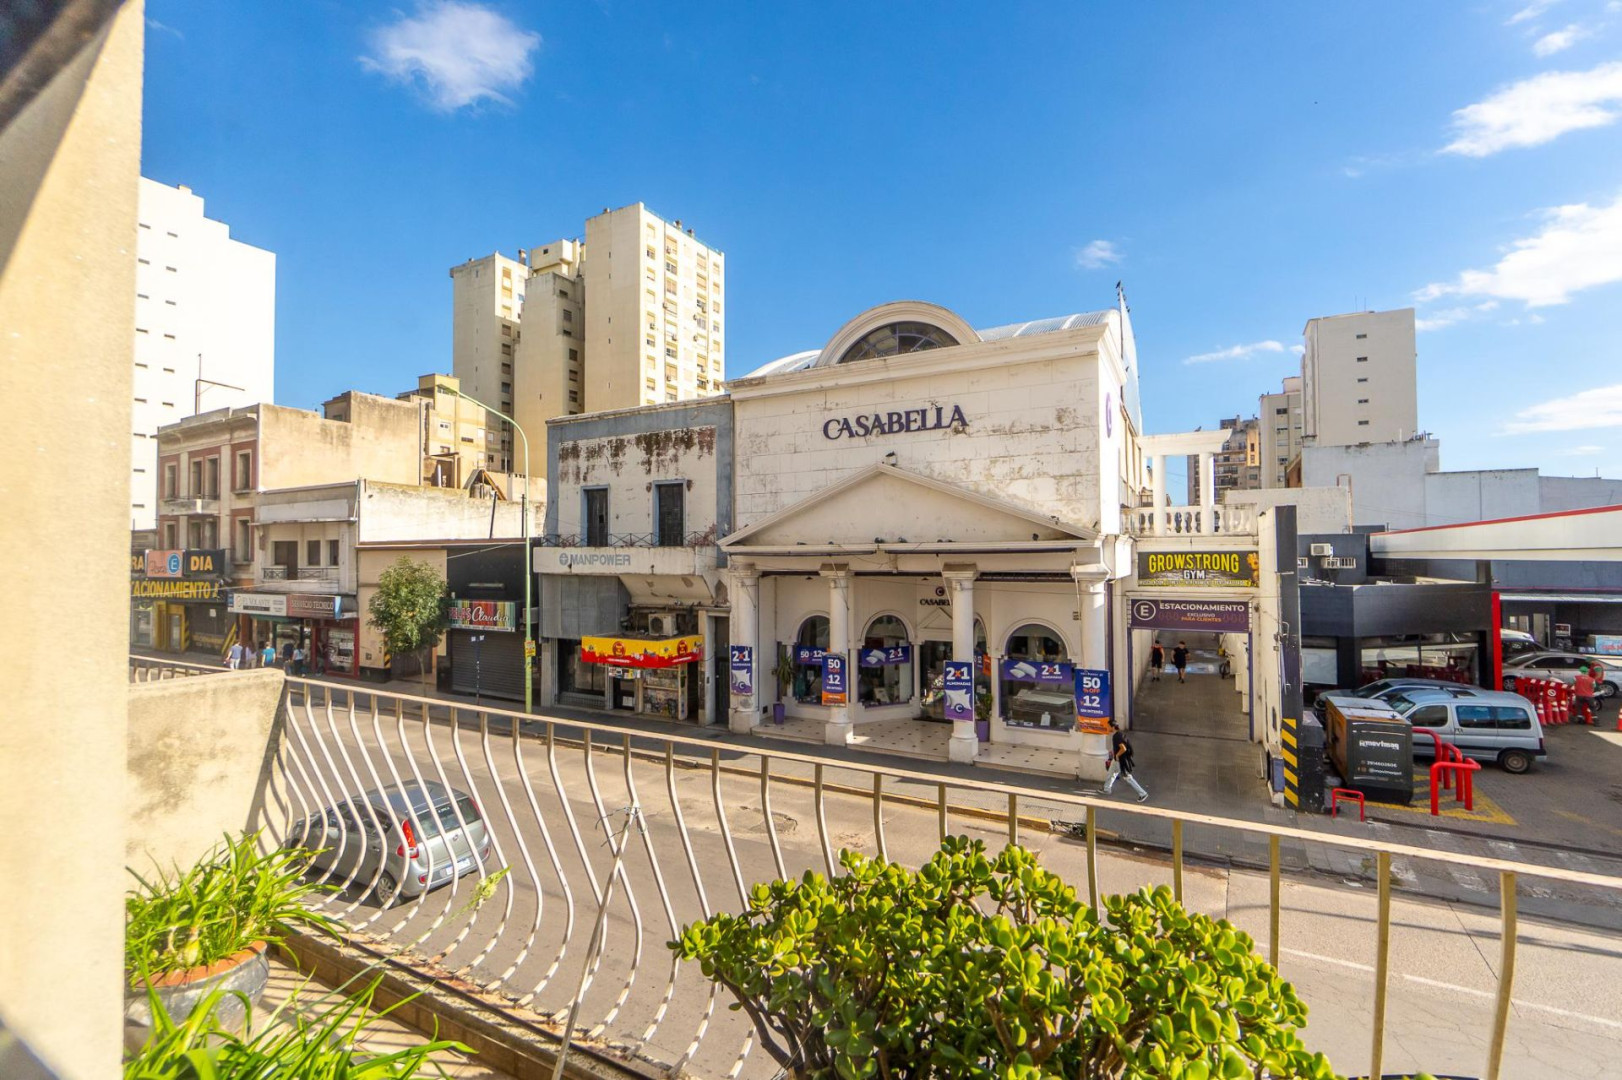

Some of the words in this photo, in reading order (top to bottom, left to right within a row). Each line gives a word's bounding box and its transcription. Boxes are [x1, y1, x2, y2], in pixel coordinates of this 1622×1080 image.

[823, 405, 969, 440] CASABELLA
[191, 556, 213, 571] DIA
[570, 554, 631, 566] MANPOWER
[1149, 553, 1239, 573] GROWSTRONG
[1184, 570, 1205, 579] GYM
[1160, 603, 1245, 612] ESTACIONAMIENTO
[828, 659, 841, 669] 50
[1083, 677, 1101, 689] 50
